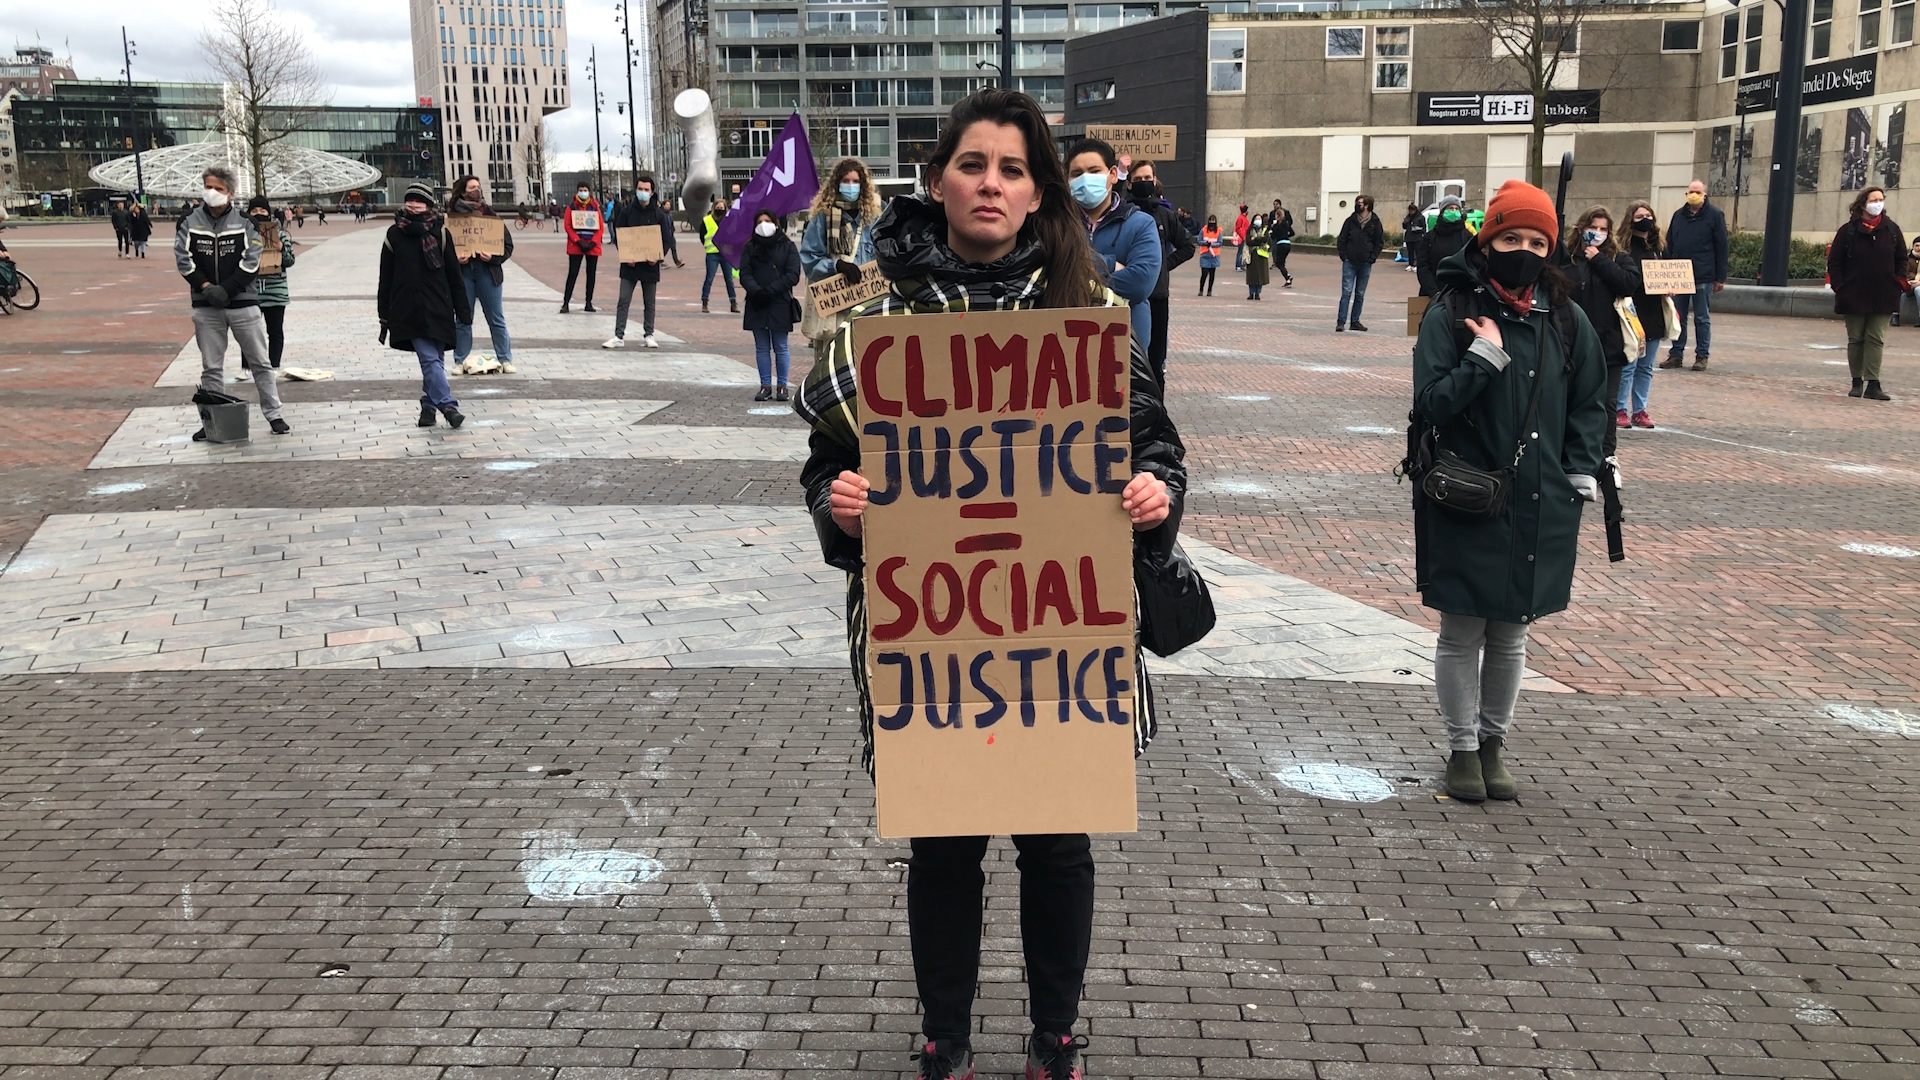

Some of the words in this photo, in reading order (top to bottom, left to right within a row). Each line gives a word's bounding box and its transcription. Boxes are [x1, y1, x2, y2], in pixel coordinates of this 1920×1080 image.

[1826, 71, 1841, 90] De
[1842, 68, 1873, 91] Slegte
[1429, 110, 1459, 118] Hoogstraat
[1460, 109, 1480, 117] 137-139
[1487, 100, 1529, 116] Hi-Fi
[1543, 104, 1587, 115] lubben
[1089, 129, 1161, 141] NEOLIBERALISM
[1113, 144, 1140, 154] DEATH
[1144, 144, 1170, 154] CULT
[462, 227, 484, 235] HEET
[1644, 262, 1657, 270] HET
[1660, 261, 1691, 270] KLIMAAT
[870, 280, 888, 294] OOK
[860, 320, 1128, 417] CLIMATE
[863, 416, 1131, 505] JUSTICE
[870, 555, 1127, 641] SOCIAL
[877, 646, 1130, 731] JUSTICE
